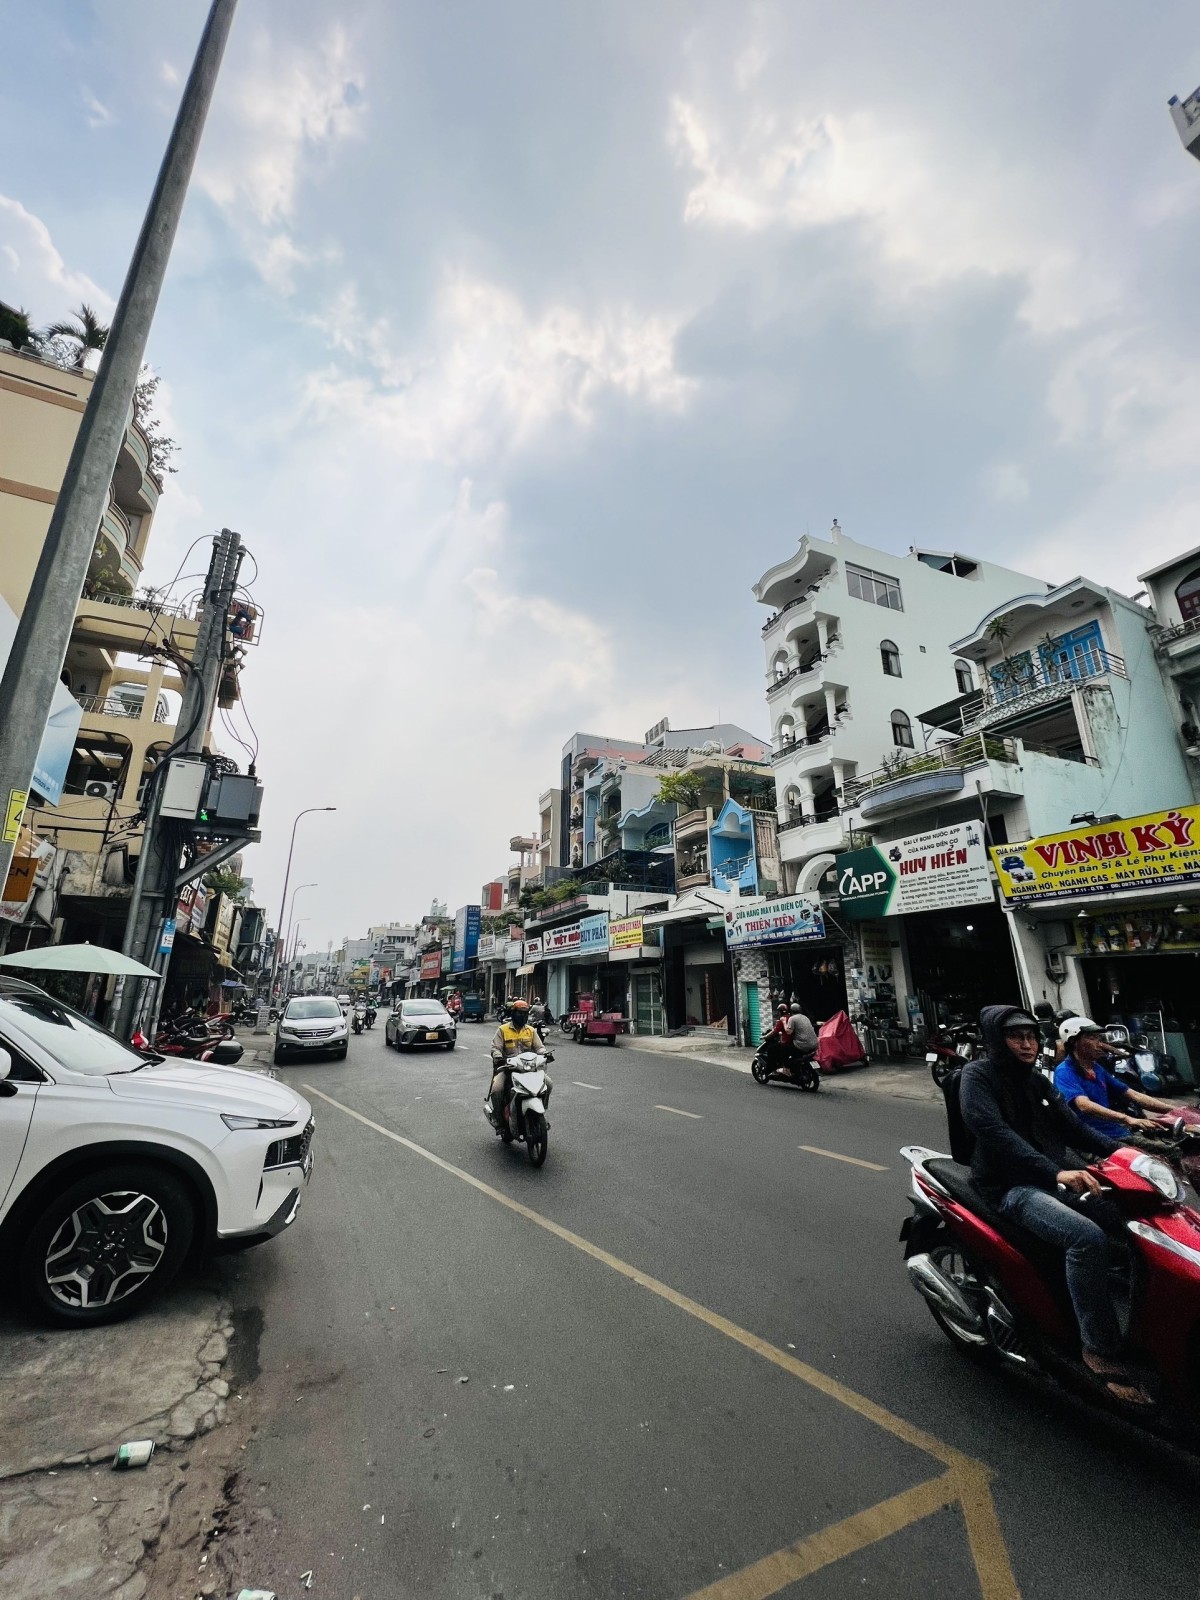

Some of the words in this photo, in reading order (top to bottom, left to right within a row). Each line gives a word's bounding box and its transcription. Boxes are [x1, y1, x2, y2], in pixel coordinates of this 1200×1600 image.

[1034, 830, 1132, 869] VINH
[899, 856, 927, 876] HUY
[1041, 866, 1076, 878] Chuyên
[1143, 852, 1165, 864] Phụ
[1090, 874, 1108, 882] GAS
[1115, 869, 1135, 879] MÁY
[1138, 864, 1159, 876] RỬA
[1162, 864, 1175, 873] XE
[848, 870, 887, 895] APP
[795, 900, 803, 908] CƠ
